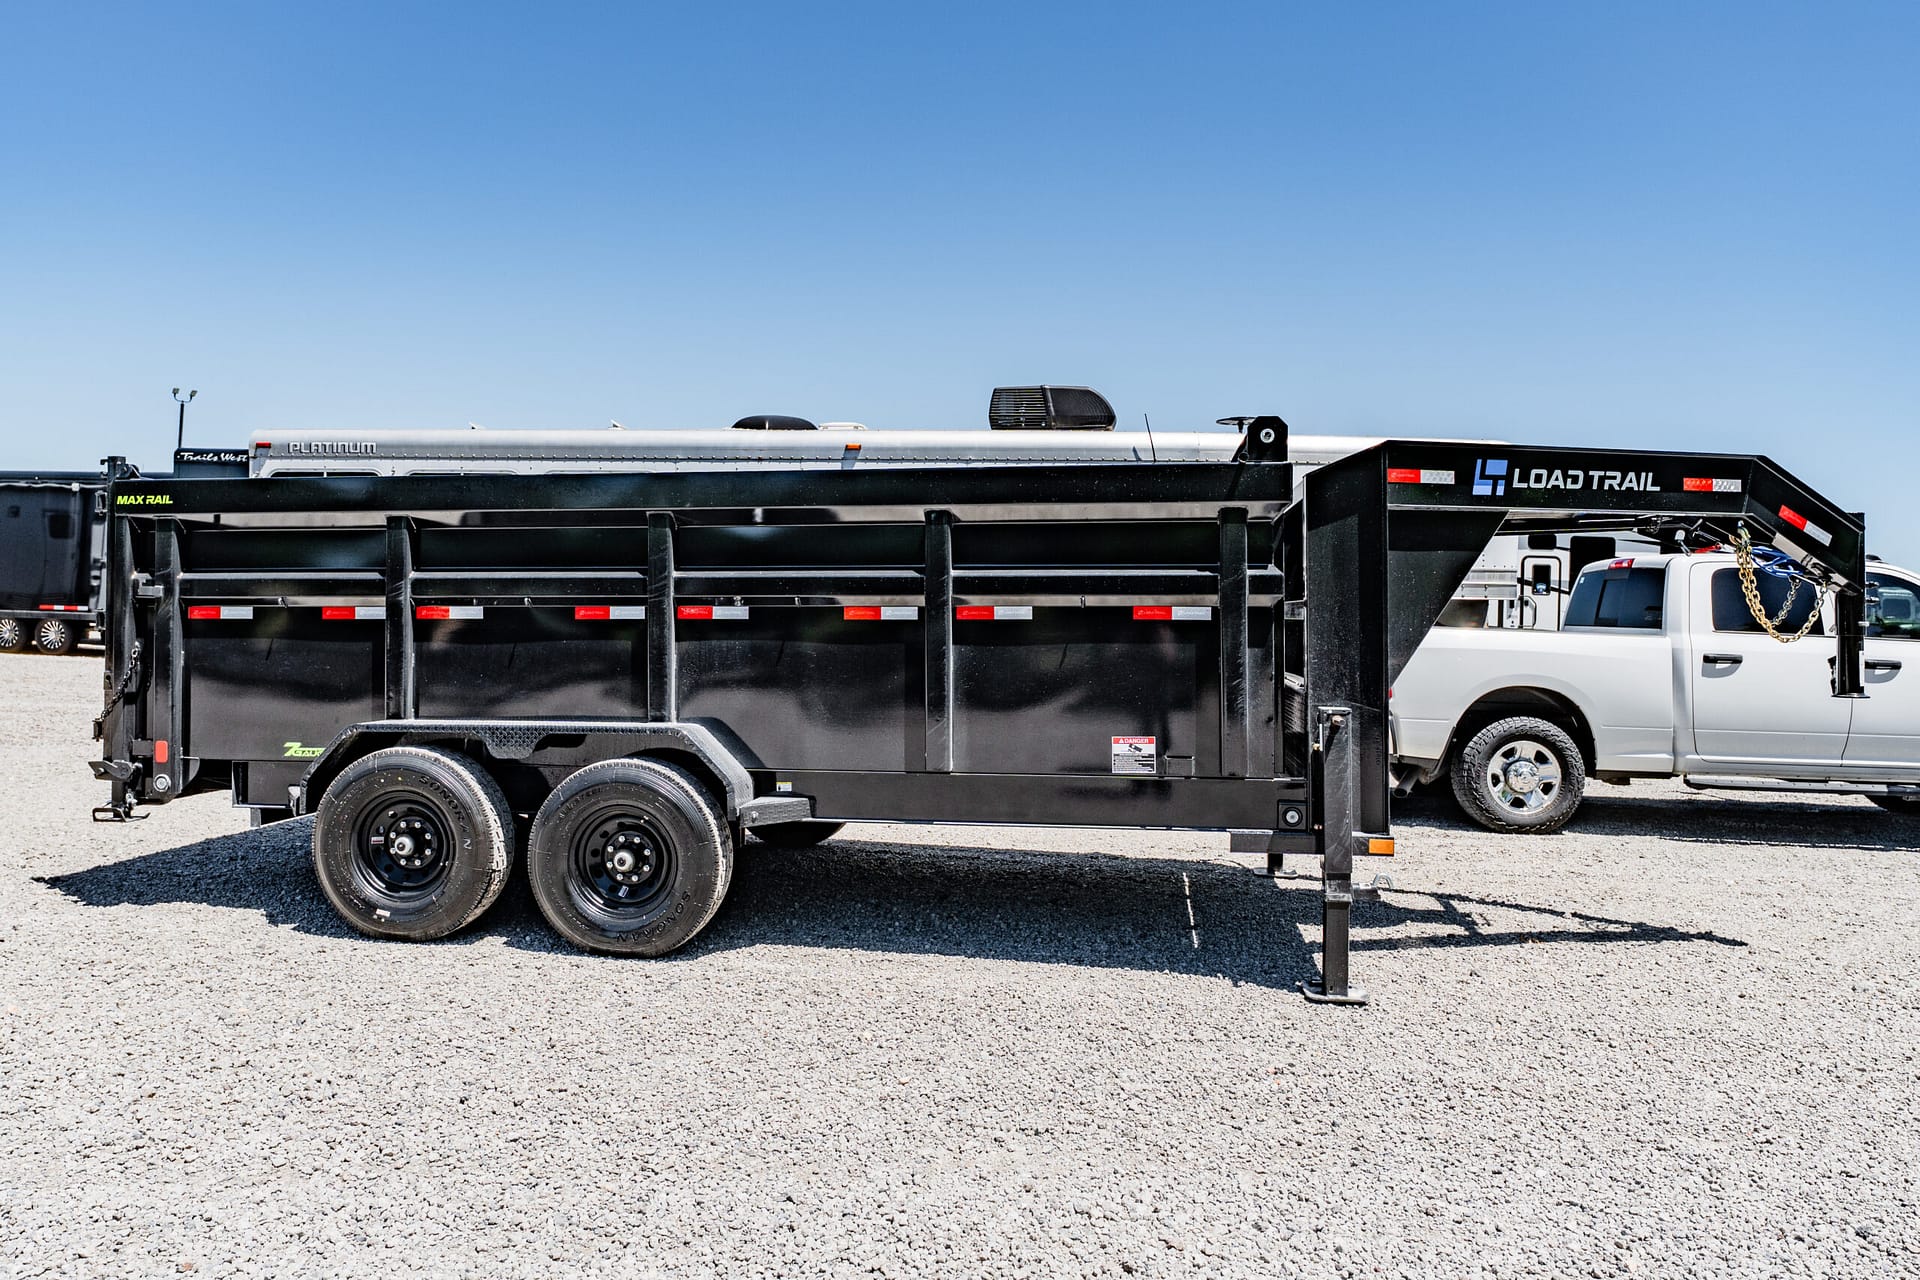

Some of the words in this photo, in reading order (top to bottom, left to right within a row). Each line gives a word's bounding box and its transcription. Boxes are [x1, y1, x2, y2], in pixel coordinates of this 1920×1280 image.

[288, 441, 377, 454] PLATINUM
[180, 452, 218, 462] Trails
[219, 452, 248, 462] West
[1512, 468, 1584, 490] LOAD
[1588, 470, 1661, 492] TRAIL
[116, 495, 145, 505] MAX
[145, 494, 174, 505] RAIL
[418, 774, 473, 851] SONORAN
[616, 890, 691, 943] SONORAN
